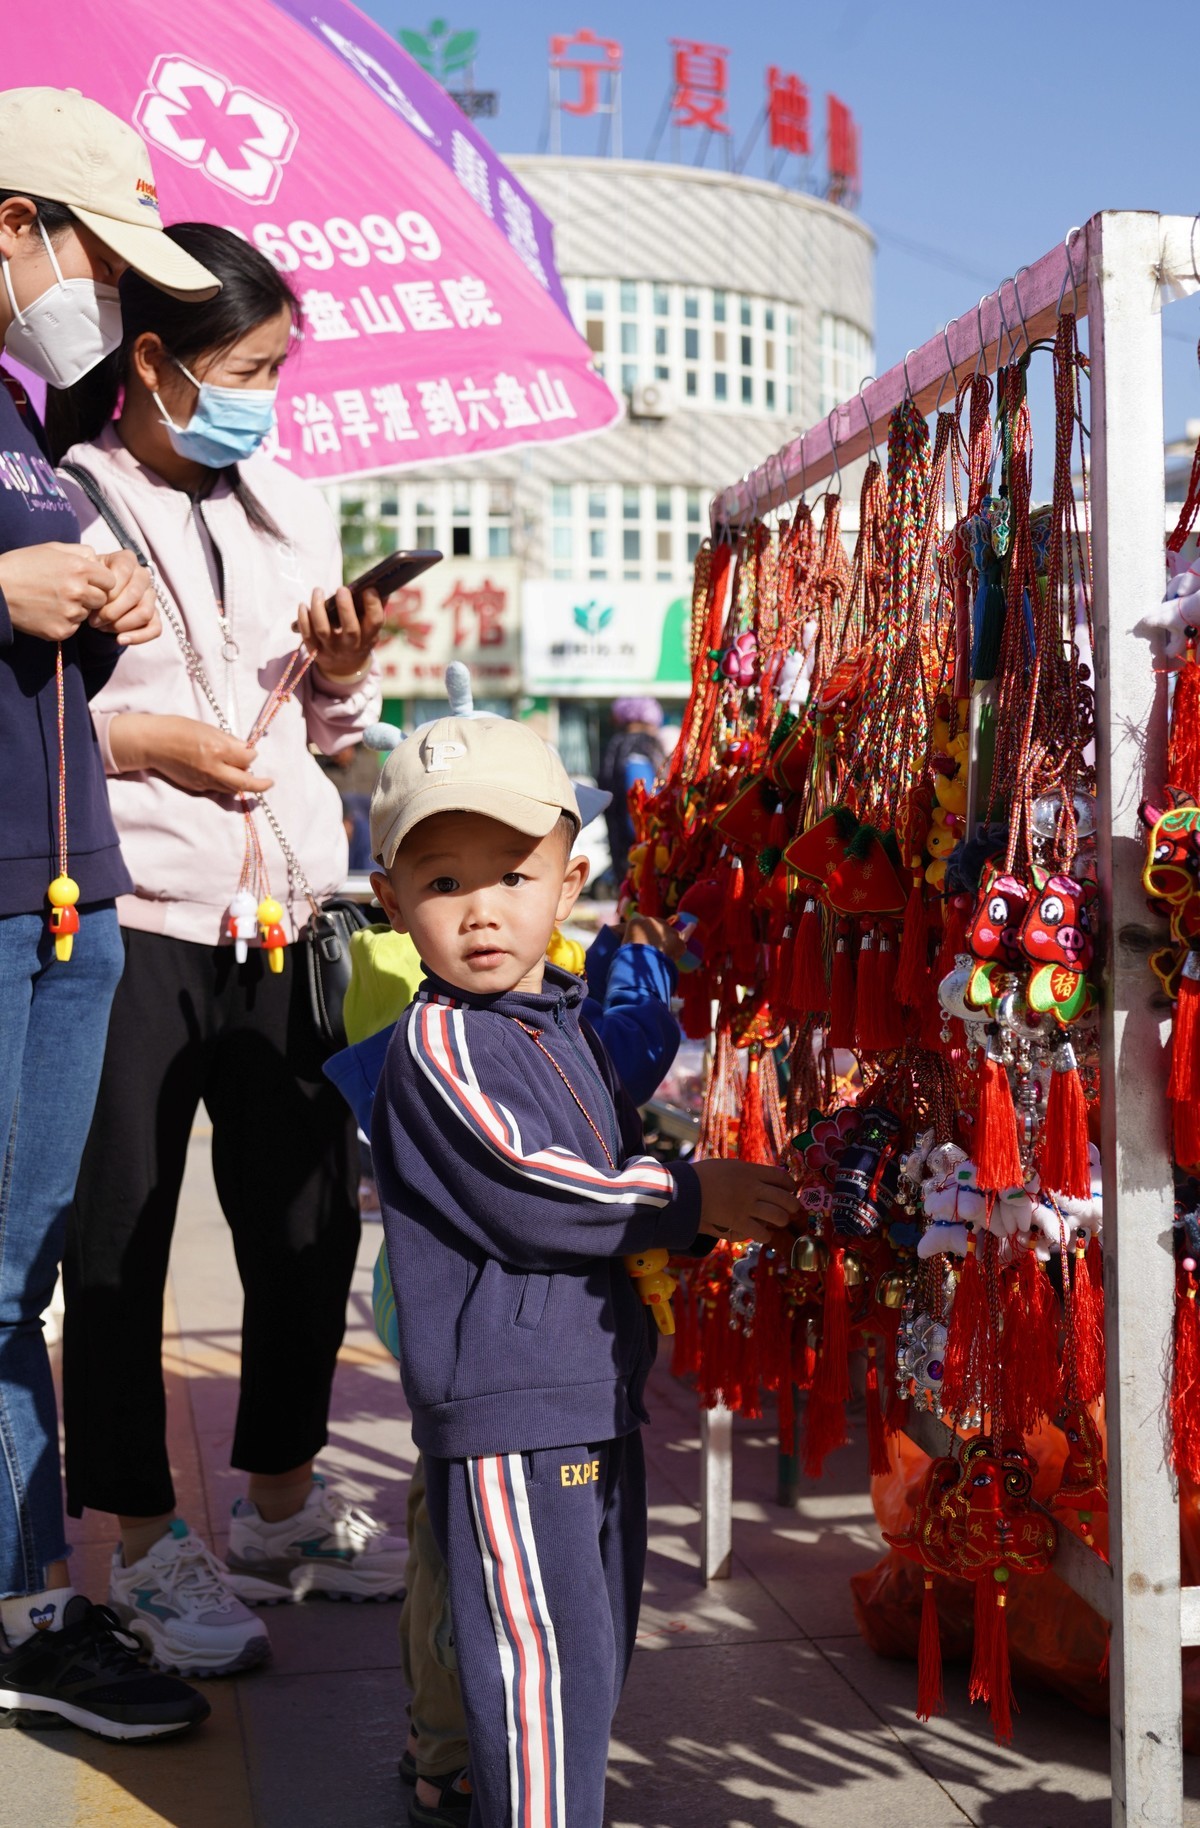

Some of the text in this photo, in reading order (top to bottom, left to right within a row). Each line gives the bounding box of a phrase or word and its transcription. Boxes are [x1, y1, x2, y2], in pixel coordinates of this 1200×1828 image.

[222, 210, 442, 272] 69999
[289, 275, 502, 342] 盘山医院
[427, 741, 467, 773] P
[1053, 973, 1076, 997] 猪
[560, 1460, 600, 1487] EXPE
